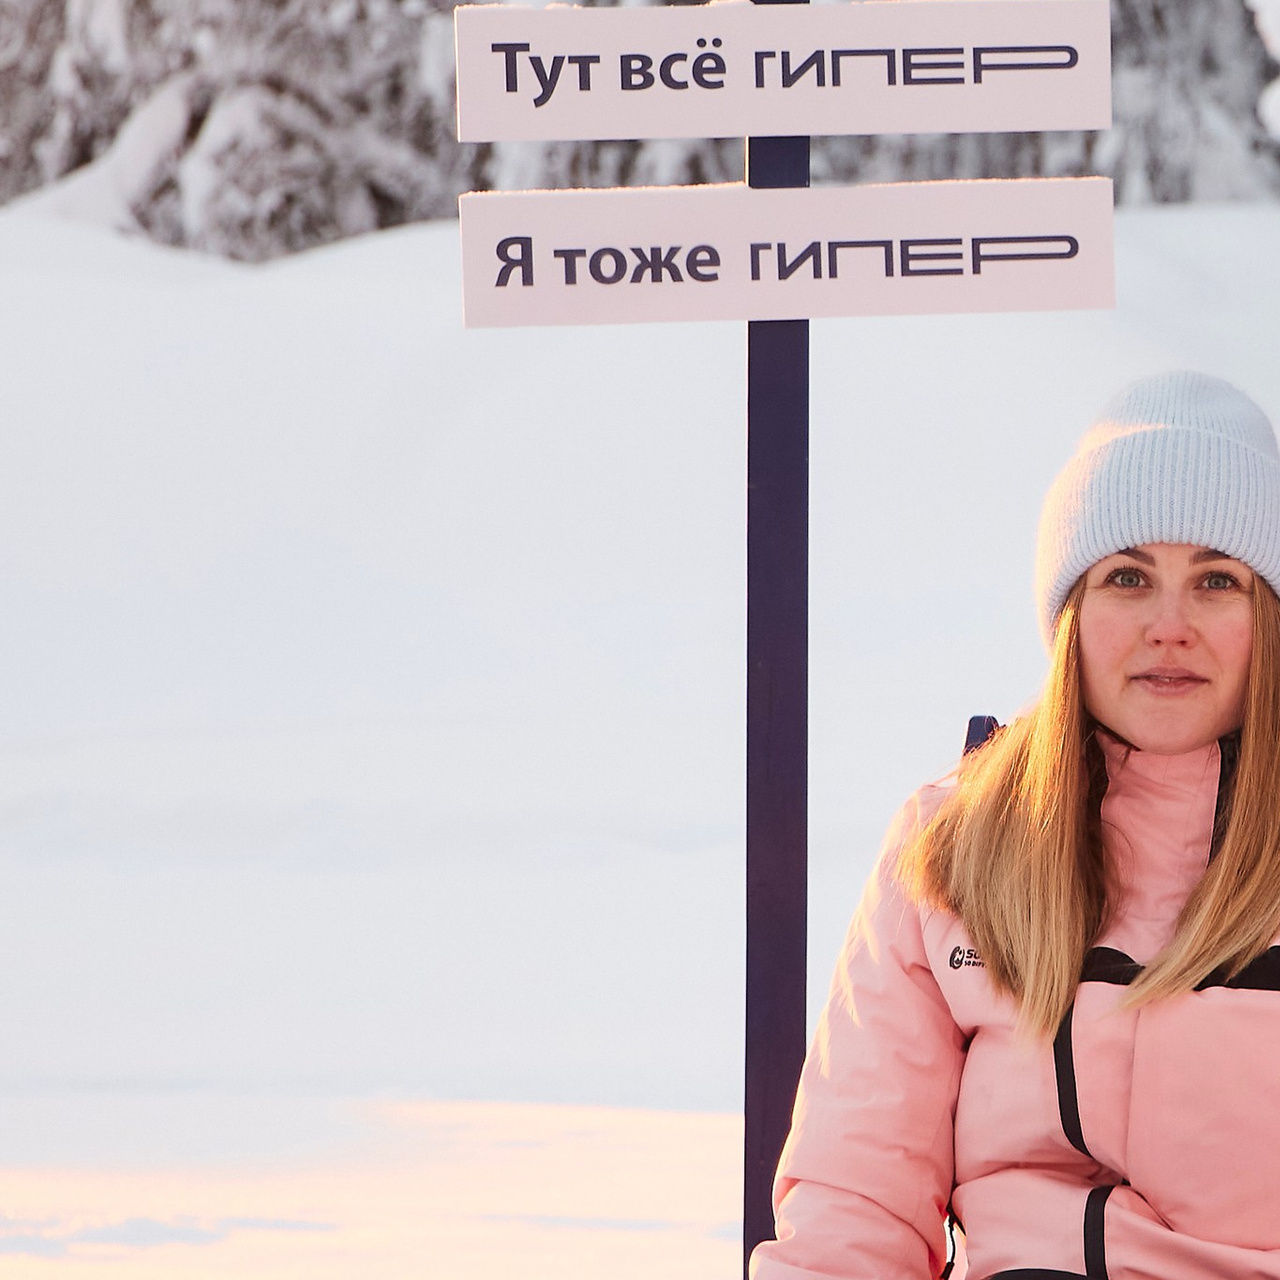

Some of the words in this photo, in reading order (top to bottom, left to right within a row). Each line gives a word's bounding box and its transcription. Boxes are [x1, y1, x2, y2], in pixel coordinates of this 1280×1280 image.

[490, 42, 601, 109] Тут
[619, 37, 727, 91] всё
[754, 45, 1079, 89] ГИПЕР
[494, 236, 534, 288] Я
[553, 244, 721, 286] тоже
[749, 234, 1080, 281] ГИПЕР
